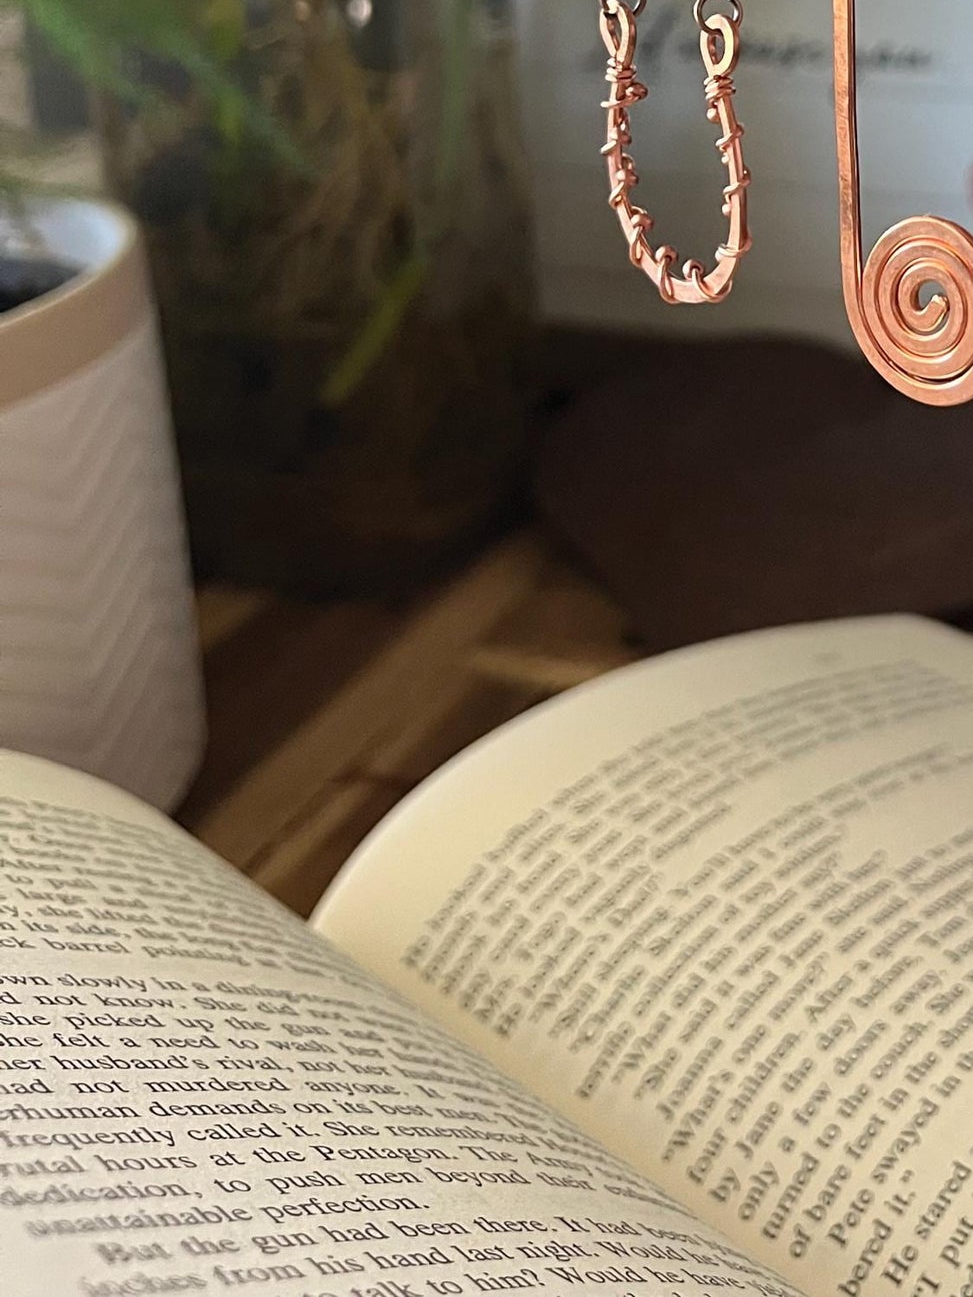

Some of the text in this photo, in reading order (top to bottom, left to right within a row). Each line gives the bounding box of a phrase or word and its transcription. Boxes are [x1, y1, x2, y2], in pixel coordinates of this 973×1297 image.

[44, 938, 131, 953] barrel
[57, 974, 190, 992] slowly in
[33, 991, 247, 1012] not know. She
[64, 1014, 167, 1030] picked
[174, 1016, 214, 1032] up
[224, 1017, 271, 1031] the
[53, 1033, 338, 1054] felt a need to wash
[50, 1055, 392, 1076] husband's rival, not her
[70, 1078, 446, 1099] not murdered anyone. It
[149, 1099, 497, 1123] demands on its best men.
[0, 1121, 540, 1150] frequently called it. She remembered
[93, 1154, 197, 1172] hours
[209, 1151, 246, 1167] at
[252, 1147, 306, 1163] the
[309, 1145, 461, 1163] Pentagon.
[459, 1145, 518, 1163] The
[686, 1126, 727, 1186] four
[0, 1167, 597, 1206] dedication, to push men beyond their
[789, 1086, 910, 1258] of bare feet in
[826, 1097, 940, 1248] Pete swayed
[761, 1151, 820, 1240] turned
[24, 1194, 430, 1237] unattainable perfection.
[880, 1244, 919, 1288] He
[914, 1159, 972, 1240] stared
[97, 1216, 642, 1265] But the gun had been there. It had
[212, 1240, 719, 1287] from his hand last night. Would he
[837, 1218, 893, 1297] bered
[426, 1280, 463, 1295] to
[463, 1268, 546, 1292] him?
[544, 1266, 648, 1285] Would
[643, 1266, 685, 1284] he
[681, 1268, 747, 1290] have
